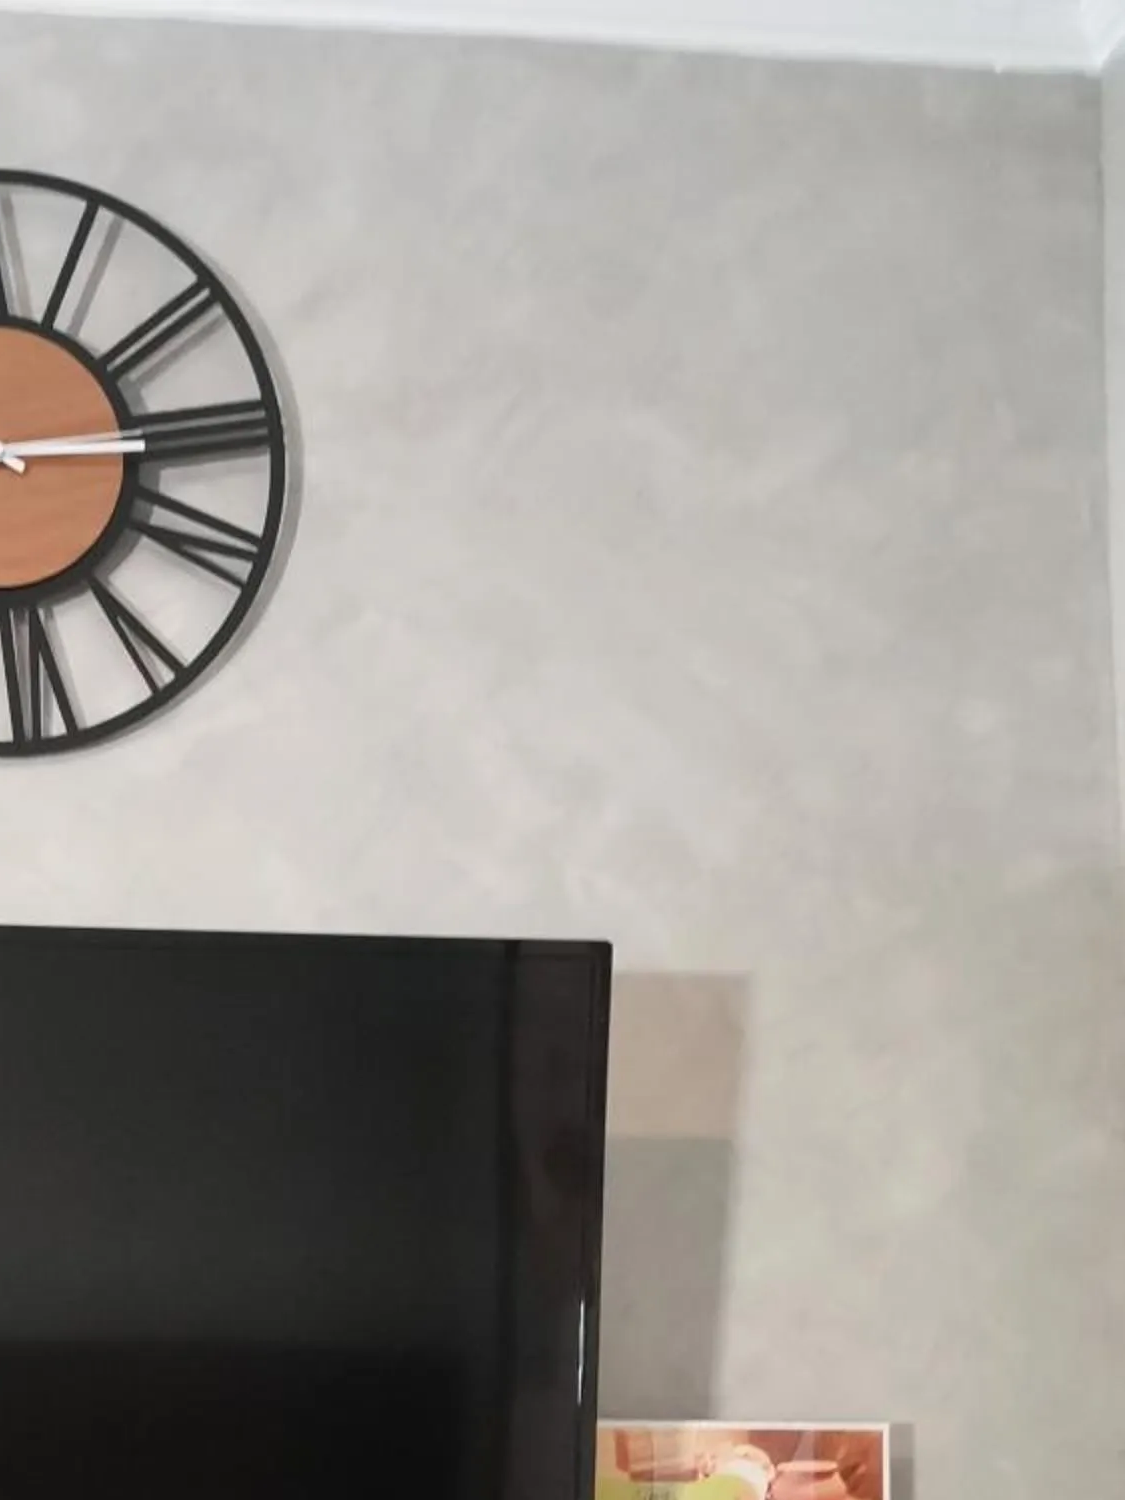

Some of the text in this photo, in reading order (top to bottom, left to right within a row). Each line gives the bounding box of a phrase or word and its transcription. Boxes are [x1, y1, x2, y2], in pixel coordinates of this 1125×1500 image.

[100, 274, 220, 381] II
[133, 399, 271, 464] III
[127, 485, 263, 592] IV
[85, 575, 187, 695] V
